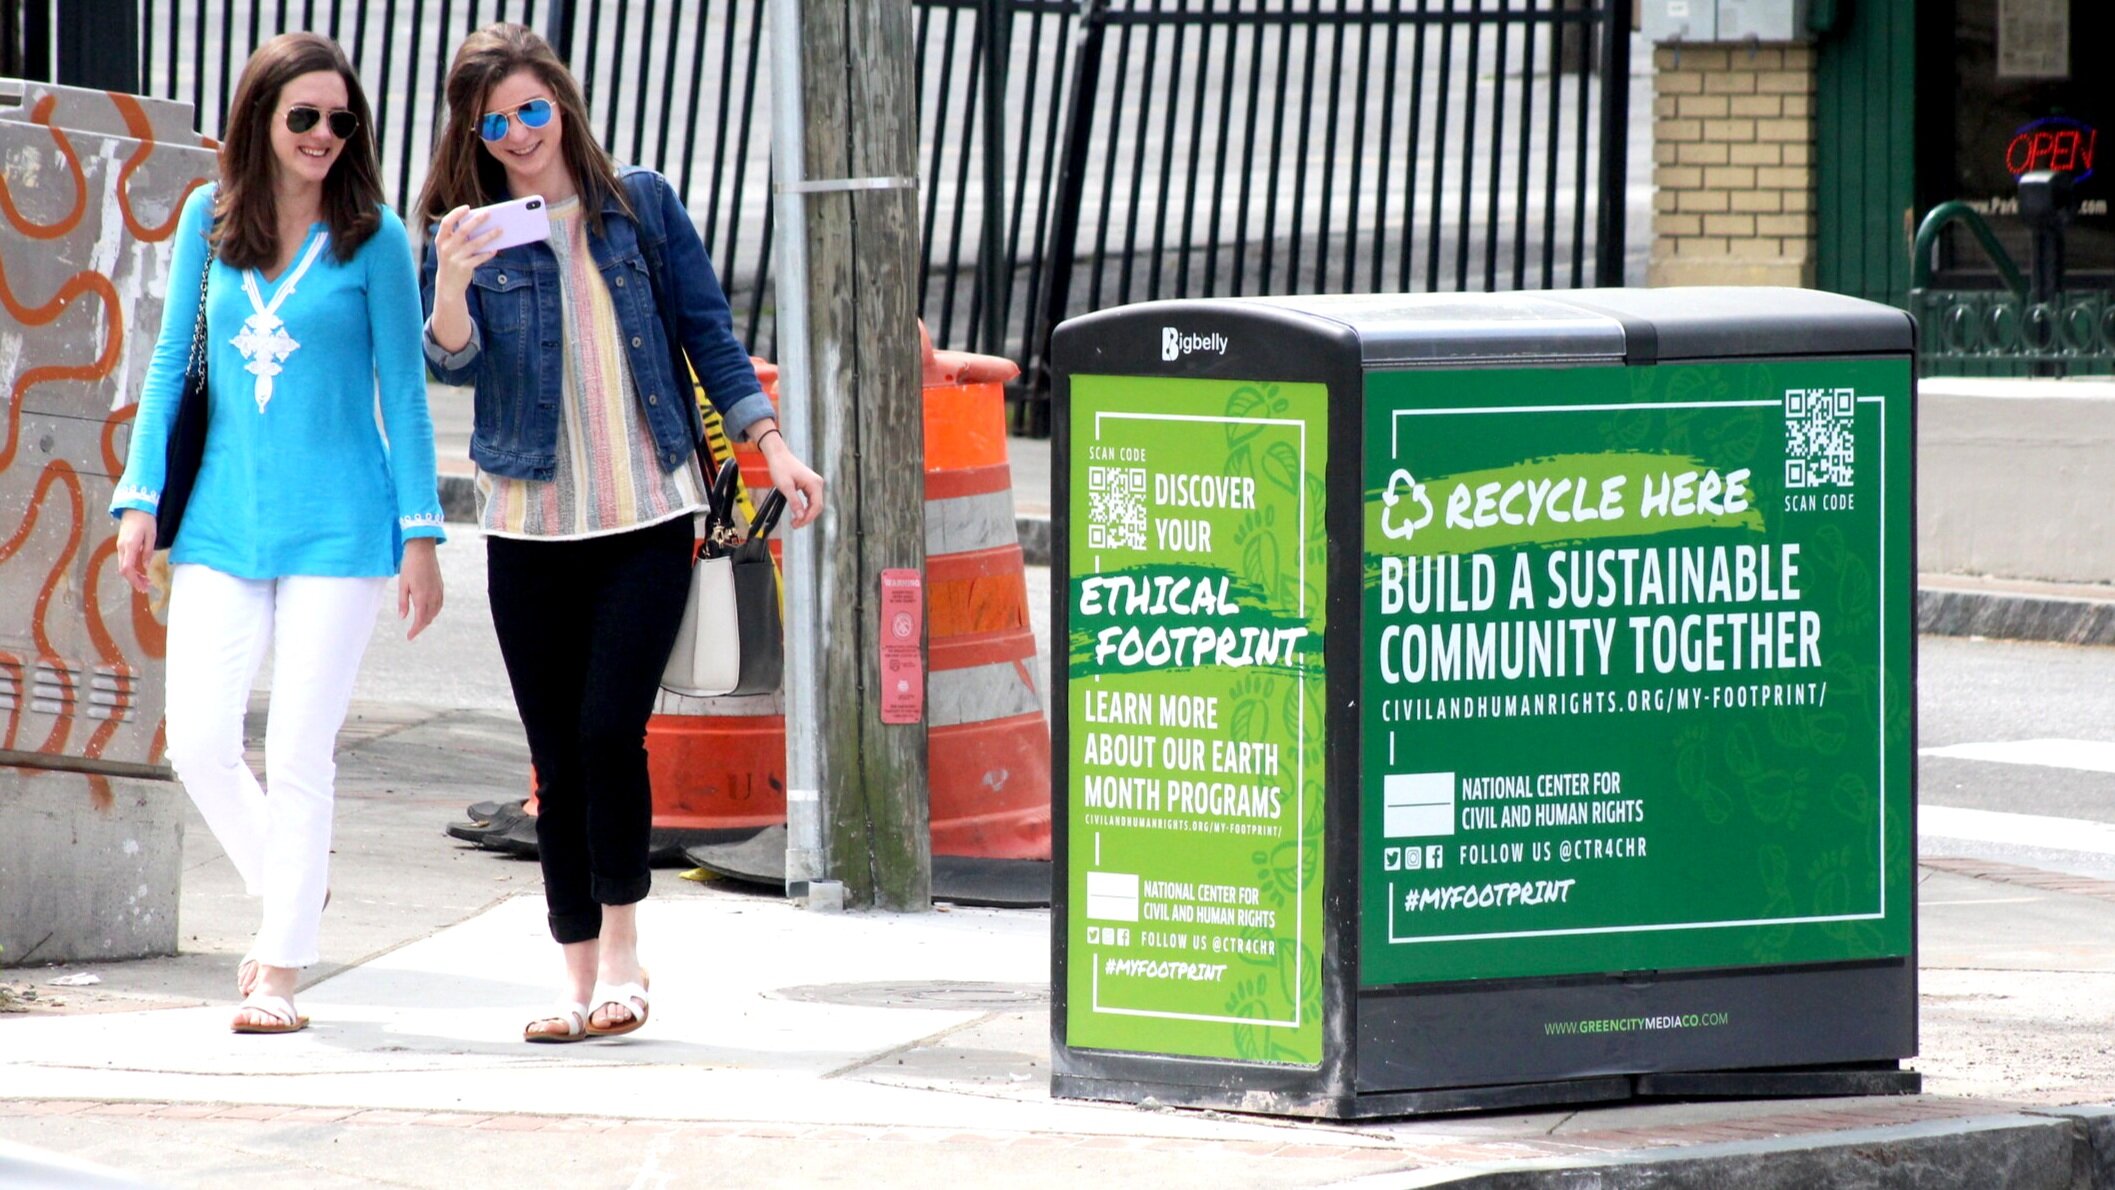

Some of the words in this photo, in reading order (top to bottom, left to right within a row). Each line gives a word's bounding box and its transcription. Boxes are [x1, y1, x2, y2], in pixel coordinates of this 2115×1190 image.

[2006, 129, 2096, 174] OPEN
[1162, 327, 1227, 361] Bigbelly
[1090, 446, 1114, 460] SCAN
[1120, 448, 1146, 462] CODE
[1155, 474, 1255, 509] DISCOVER
[1446, 475, 1626, 529] RECYCLE
[1640, 469, 1750, 519] HERE
[1785, 495, 1815, 511] SCAN
[1823, 494, 1854, 510] CODE
[1155, 518, 1211, 552] YOUR
[1079, 575, 1239, 616] ETHICAL
[1380, 551, 1495, 614] BUILD
[1509, 553, 1534, 609] A
[1548, 544, 1800, 608] SUSTAINABLE
[1095, 626, 1308, 666] FOOTPRINT
[1380, 618, 1616, 683] COMMUNITY
[1629, 611, 1821, 673] TOGETHER
[1086, 691, 1152, 724] LEARN
[1160, 694, 1218, 729] MORE
[1383, 682, 1826, 721] CIVILANDHUMANRIGHTS.ORG/MY-FOOTPRINT/
[1084, 733, 1156, 767] ABOUT
[1163, 737, 1205, 771] OUR
[1212, 740, 1278, 775] EARTH
[1085, 775, 1160, 810] MONTH
[1168, 780, 1280, 819] PROGRAMS
[1463, 776, 1533, 800] NATIONAL
[1537, 773, 1589, 797] CENTER
[1594, 772, 1620, 794] FOR
[1085, 814, 1282, 837] CIVILANDHUMANRIGHTS.ORG/MY-FOOTPRINT/
[1462, 807, 1497, 830] CIVIL
[1501, 805, 1531, 828] AND
[1536, 803, 1587, 826] HUMAN
[1593, 800, 1643, 823] RIGHTS
[1460, 843, 1523, 864] FOLLOW
[1533, 842, 1550, 861] US
[1560, 837, 1646, 862] @CTR4CHR
[1144, 881, 1195, 900] NATIONAL
[1198, 884, 1236, 903] CENTER
[1239, 887, 1259, 904] FOR
[1405, 879, 1575, 911] #MYFOOTPRINT
[1144, 902, 1169, 920] CIVIL
[1172, 904, 1194, 922] AND
[1196, 906, 1235, 925] HUMAN
[1238, 909, 1275, 928] RIGHTS
[1142, 931, 1187, 948] FOLLOW
[1193, 936, 1206, 950] US
[1213, 936, 1274, 955] @CTR4CHR
[1105, 959, 1227, 981] #MYFOOTPRINT
[1544, 1012, 1729, 1036] WWW.GREENCITYMEDIACO.COM
